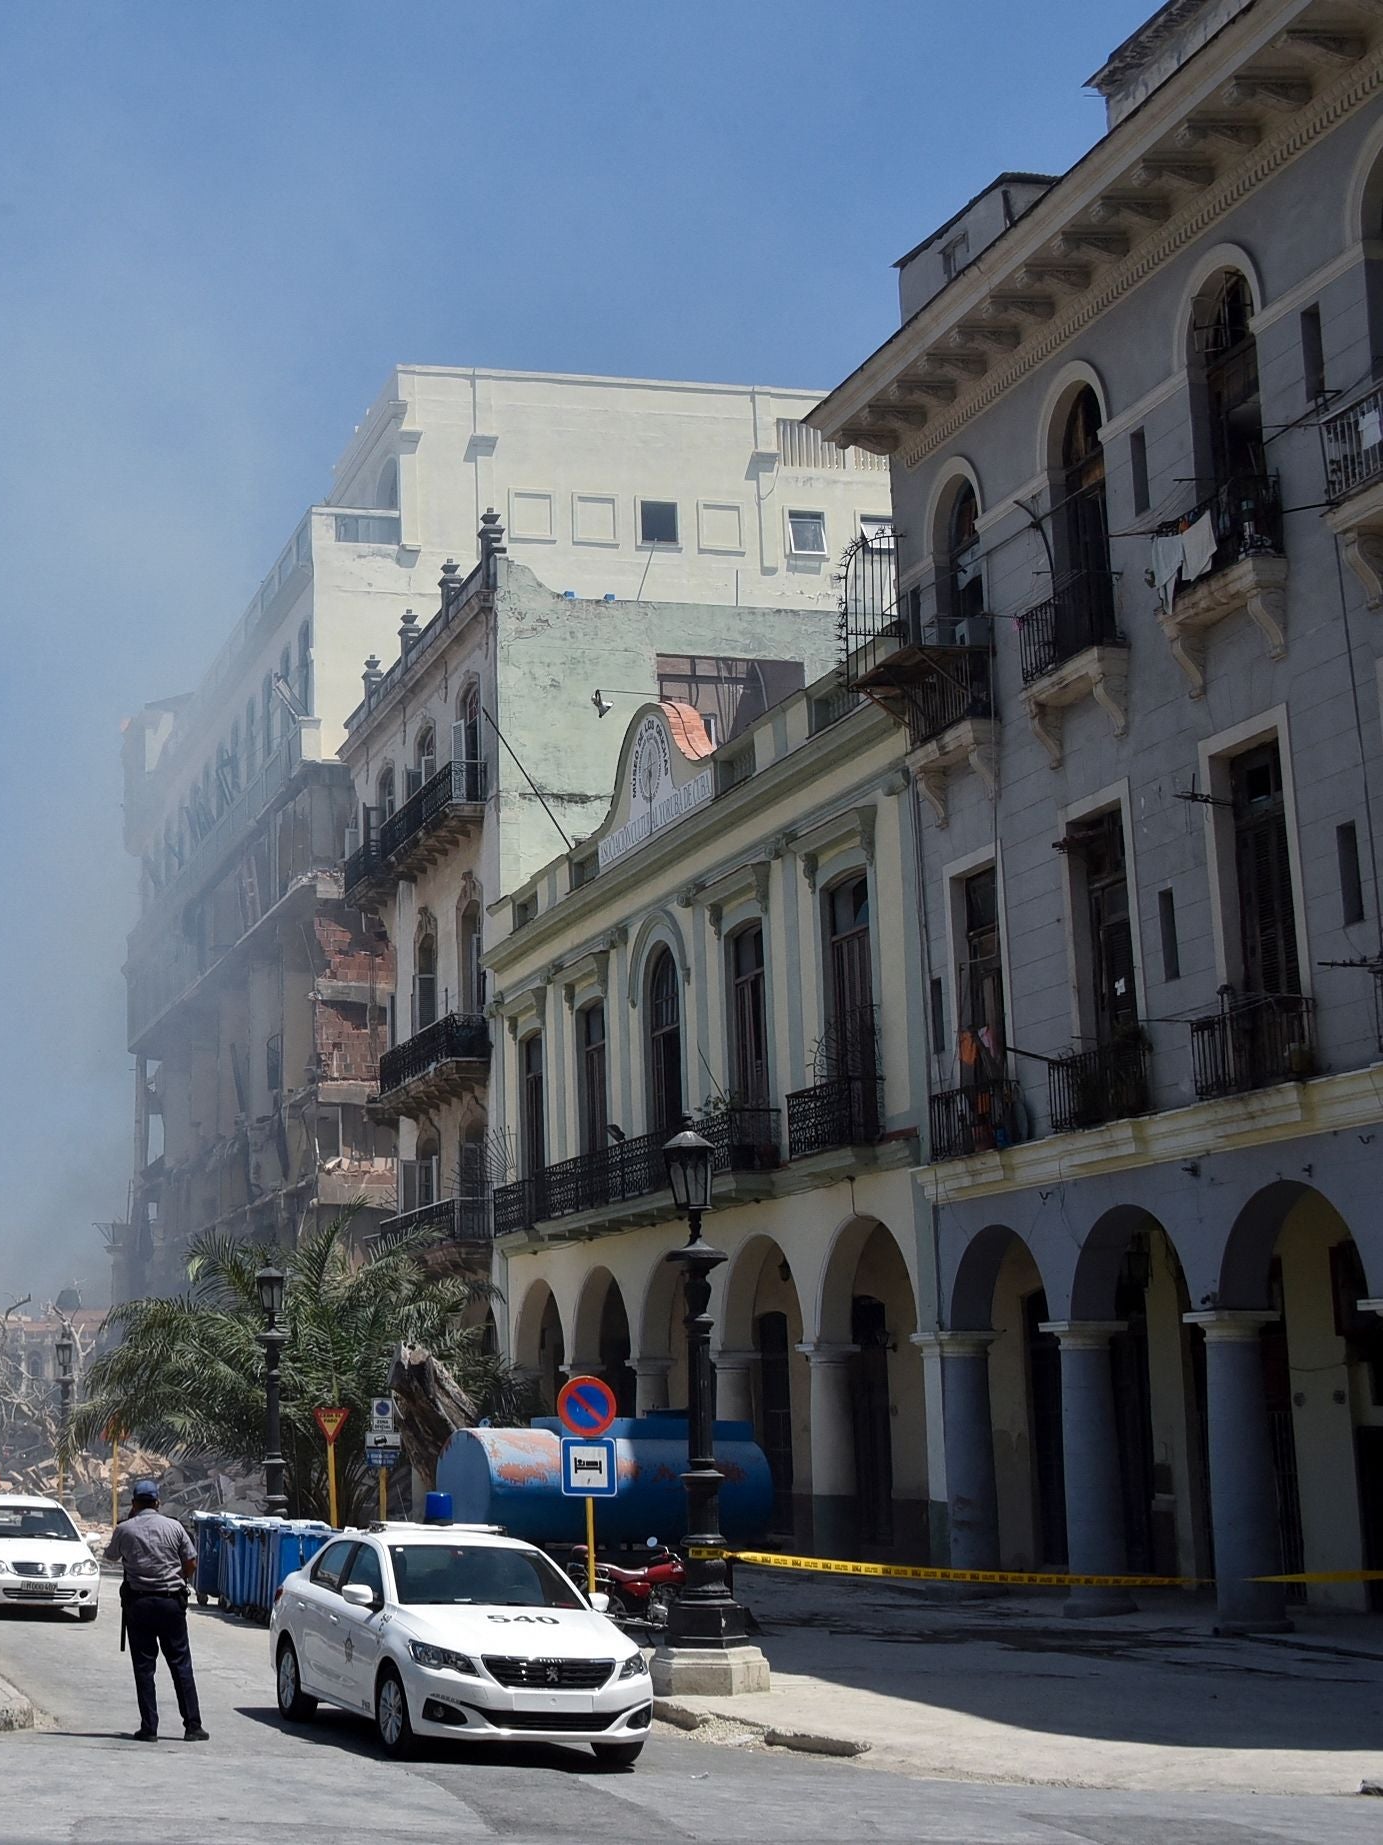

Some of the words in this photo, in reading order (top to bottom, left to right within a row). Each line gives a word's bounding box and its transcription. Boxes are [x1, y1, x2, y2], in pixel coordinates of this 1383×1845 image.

[632, 751, 640, 799] MUSEO
[637, 729, 644, 749] DE
[644, 719, 655, 733] LOS
[486, 1615, 560, 1625] 540
